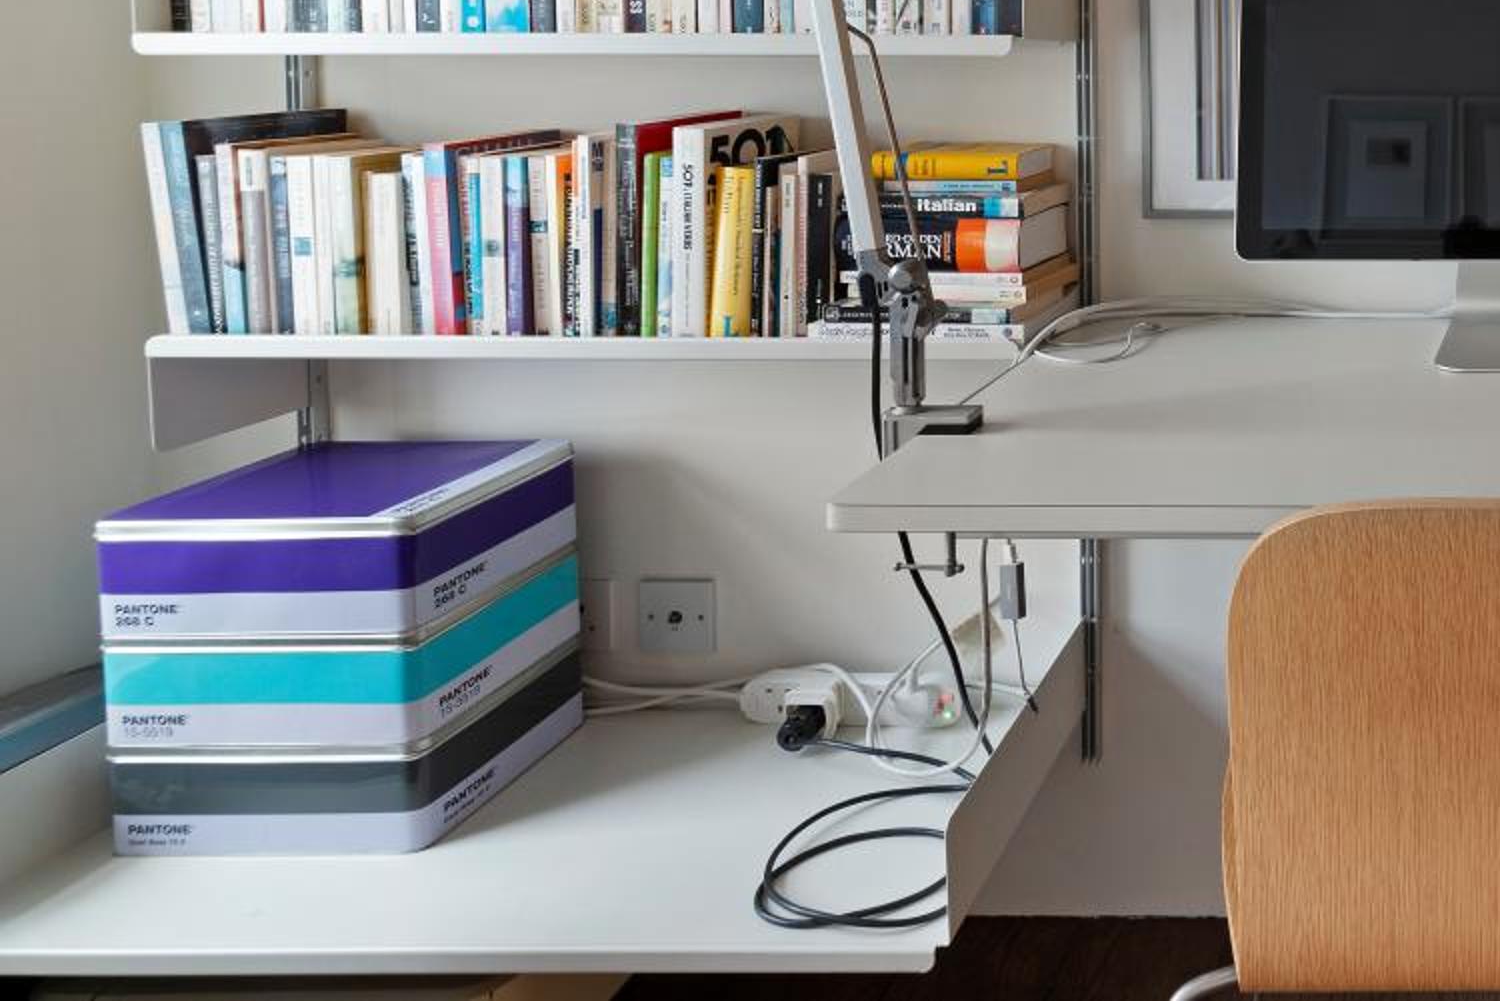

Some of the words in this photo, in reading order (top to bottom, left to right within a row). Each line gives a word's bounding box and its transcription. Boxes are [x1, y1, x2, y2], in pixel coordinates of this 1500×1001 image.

[709, 125, 795, 168] 501
[917, 198, 976, 212] Italian
[433, 562, 486, 597] PANTONE
[114, 605, 177, 616] PANTONE
[114, 617, 141, 627] 268
[145, 617, 155, 627] C
[439, 667, 493, 706] PANTONE
[121, 715, 186, 727] PANTONE
[444, 769, 496, 811] PANTONE
[127, 824, 192, 836] PANTONE
